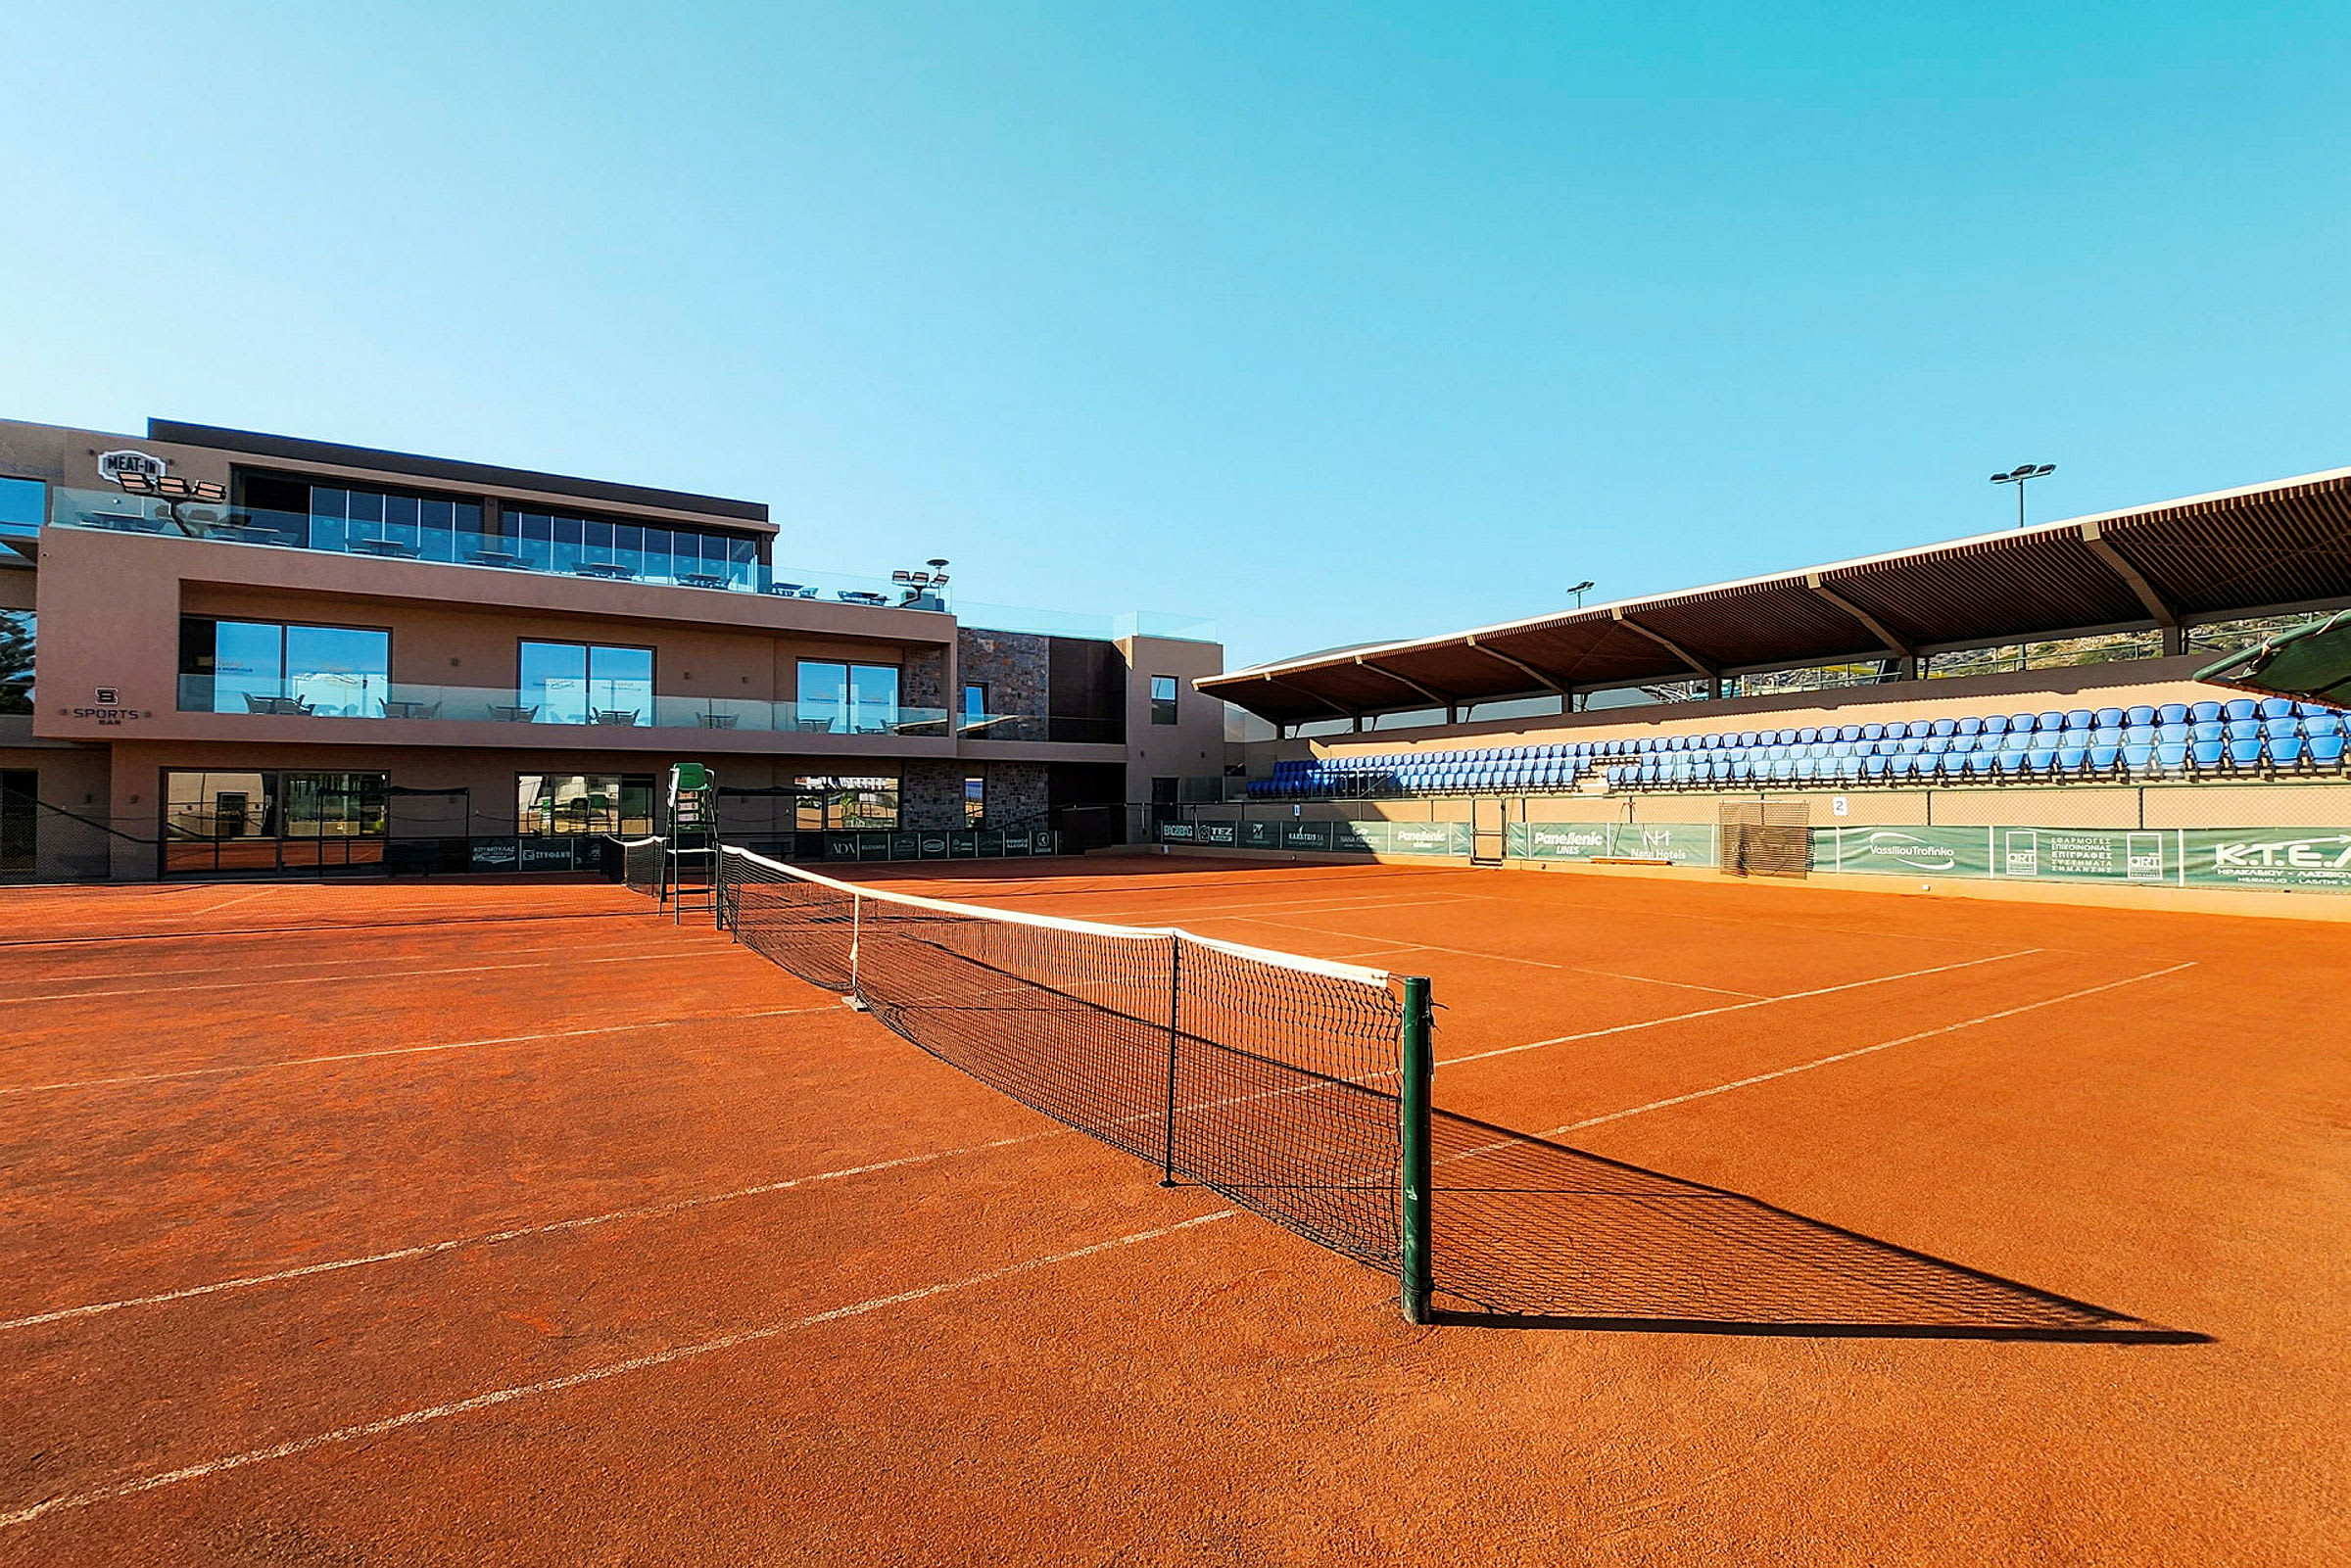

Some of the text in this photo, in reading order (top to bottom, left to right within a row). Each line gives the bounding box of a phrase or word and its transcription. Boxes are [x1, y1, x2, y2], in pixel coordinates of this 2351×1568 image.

[108, 455, 157, 474] MEAT-IN
[73, 708, 139, 720] SPORTS
[1836, 800, 1844, 811] 2
[1556, 845, 1580, 855] LINES
[1655, 848, 1686, 860] Hotels
